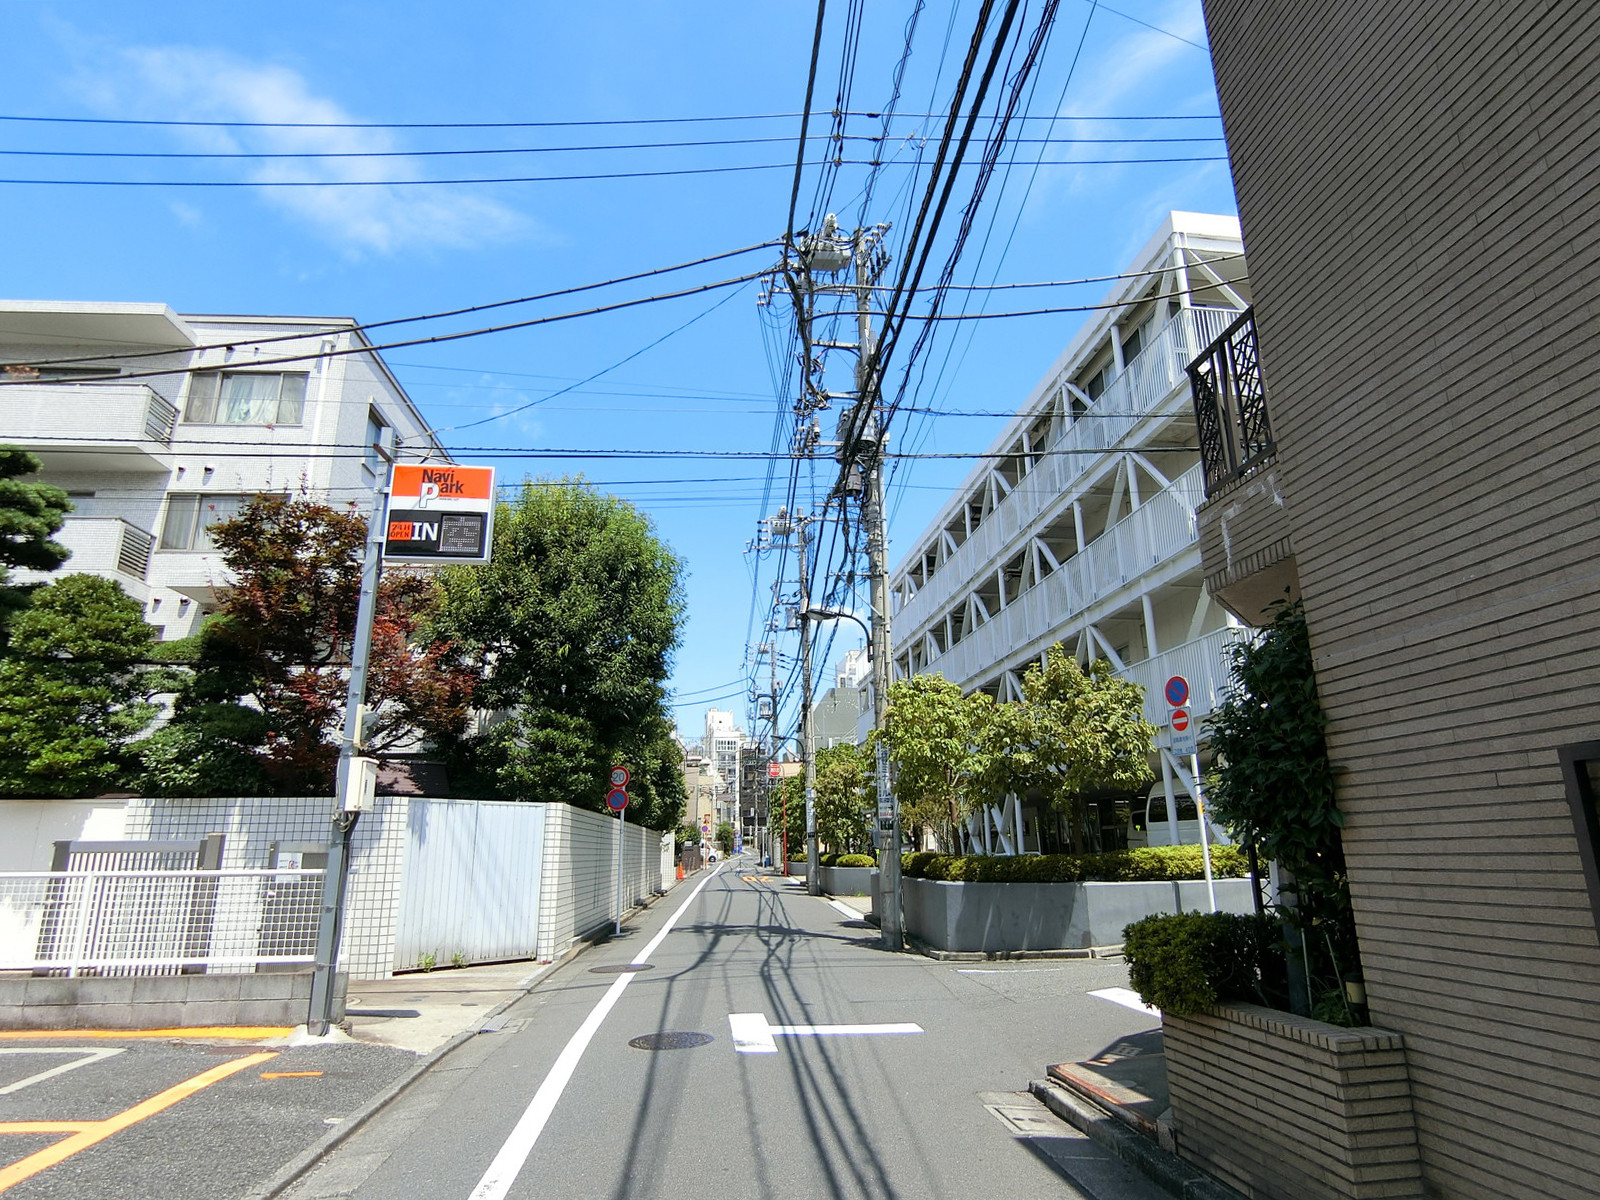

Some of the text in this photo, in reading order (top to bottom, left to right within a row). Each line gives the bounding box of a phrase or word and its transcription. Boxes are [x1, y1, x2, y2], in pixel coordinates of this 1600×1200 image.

[422, 469, 455, 483] Navi
[419, 481, 464, 508] Park
[411, 522, 439, 541] IN
[612, 772, 625, 782] 20
